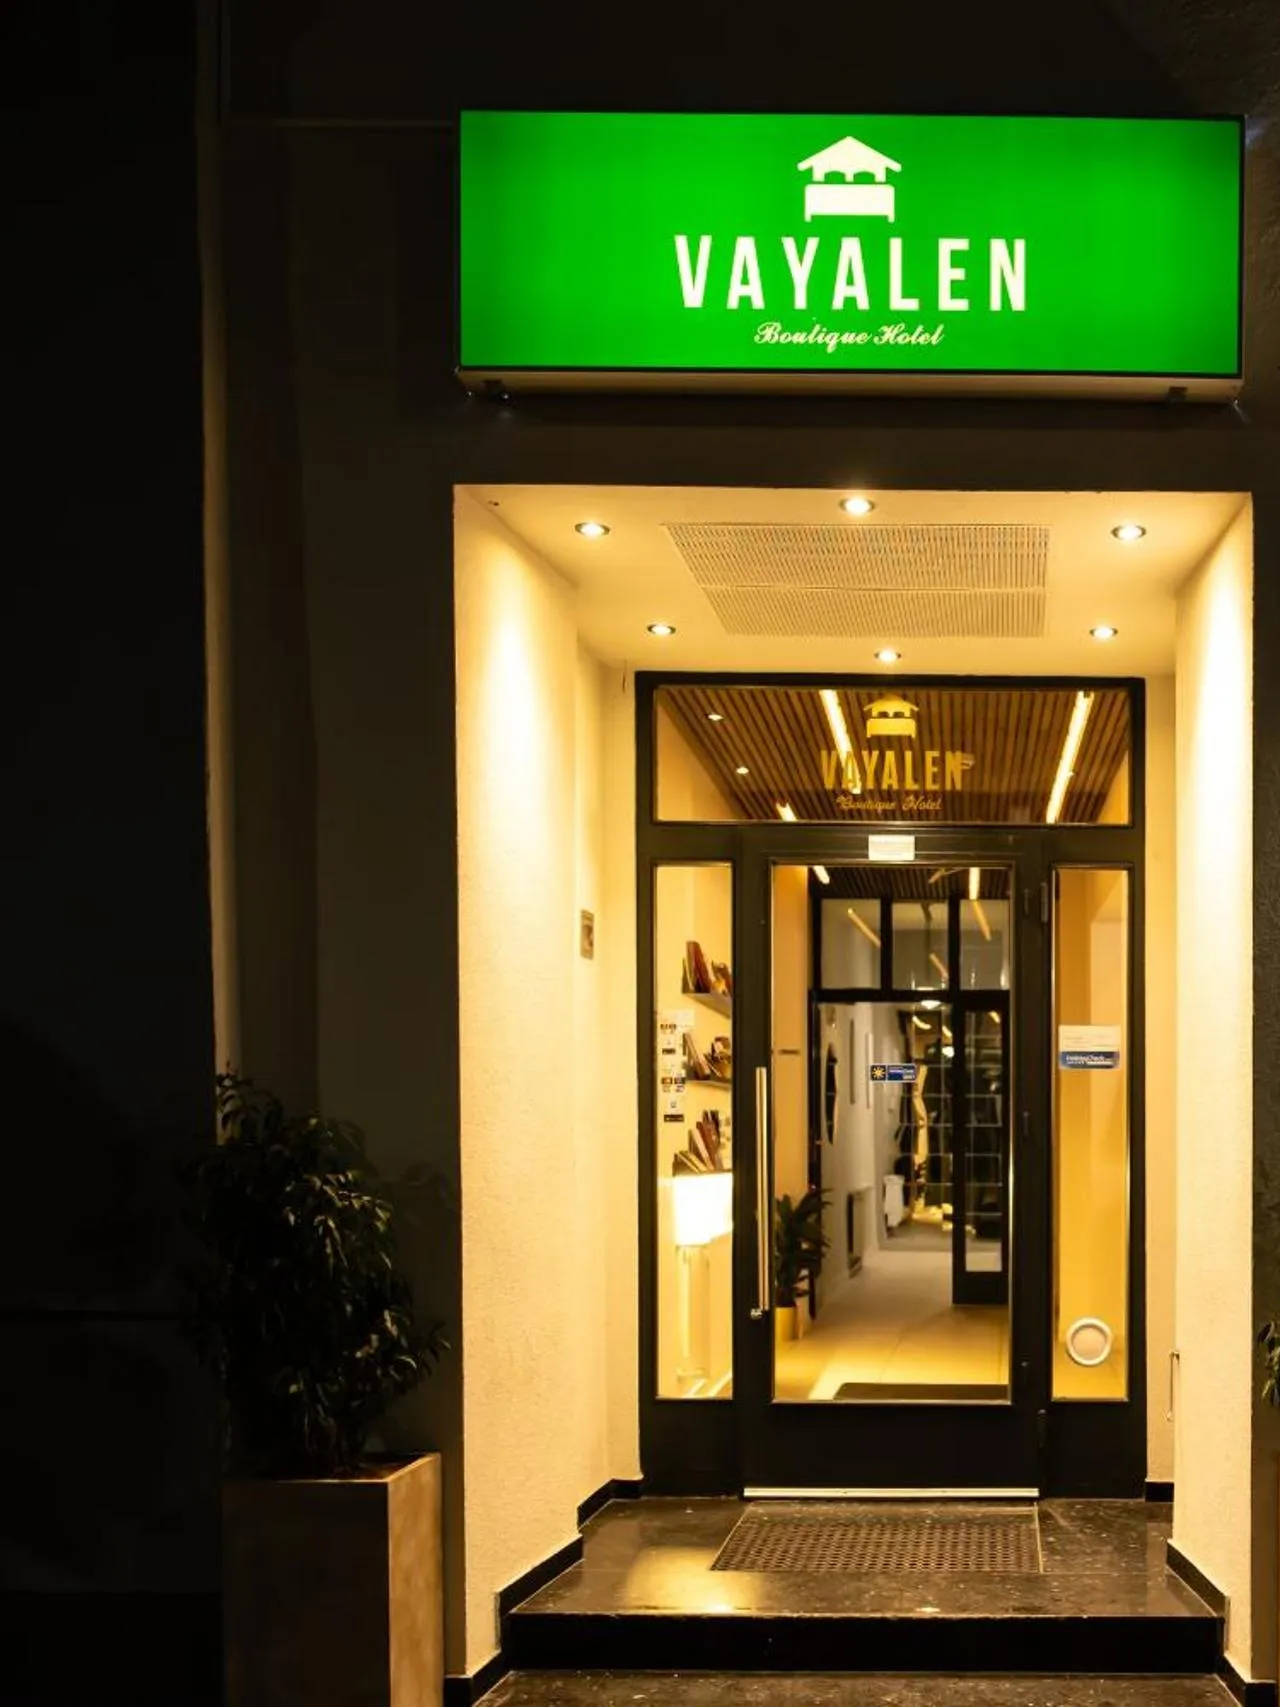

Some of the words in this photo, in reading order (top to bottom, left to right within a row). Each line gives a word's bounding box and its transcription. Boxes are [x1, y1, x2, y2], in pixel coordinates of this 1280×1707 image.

[673, 234, 1027, 312] VAYALEN
[754, 321, 871, 353] Boutique
[873, 323, 944, 345] Hotel
[820, 750, 963, 791] VAYALEN
[902, 794, 942, 811] Hotel
